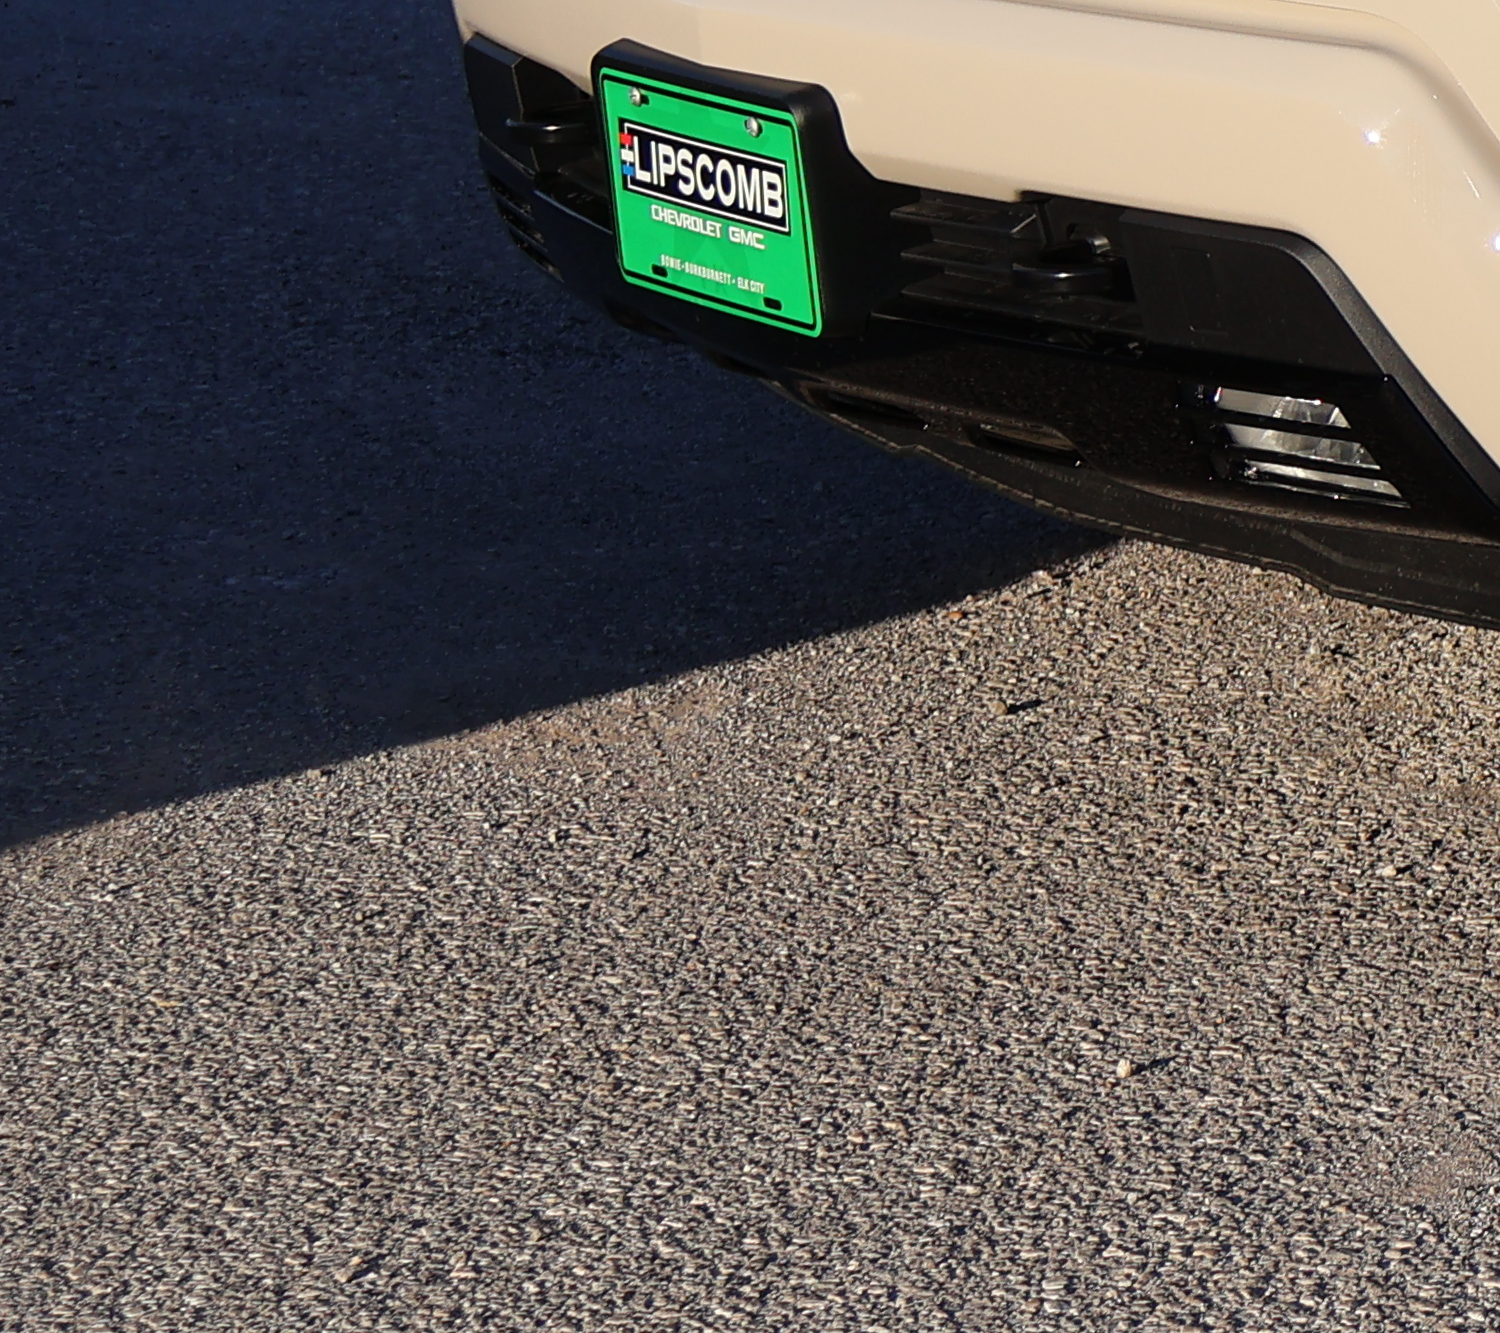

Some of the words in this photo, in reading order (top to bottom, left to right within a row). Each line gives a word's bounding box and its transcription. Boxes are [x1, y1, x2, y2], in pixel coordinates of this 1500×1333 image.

[633, 135, 783, 219] LIPSCOMB
[651, 204, 722, 239] CHEVROLET
[728, 225, 766, 250] GMC
